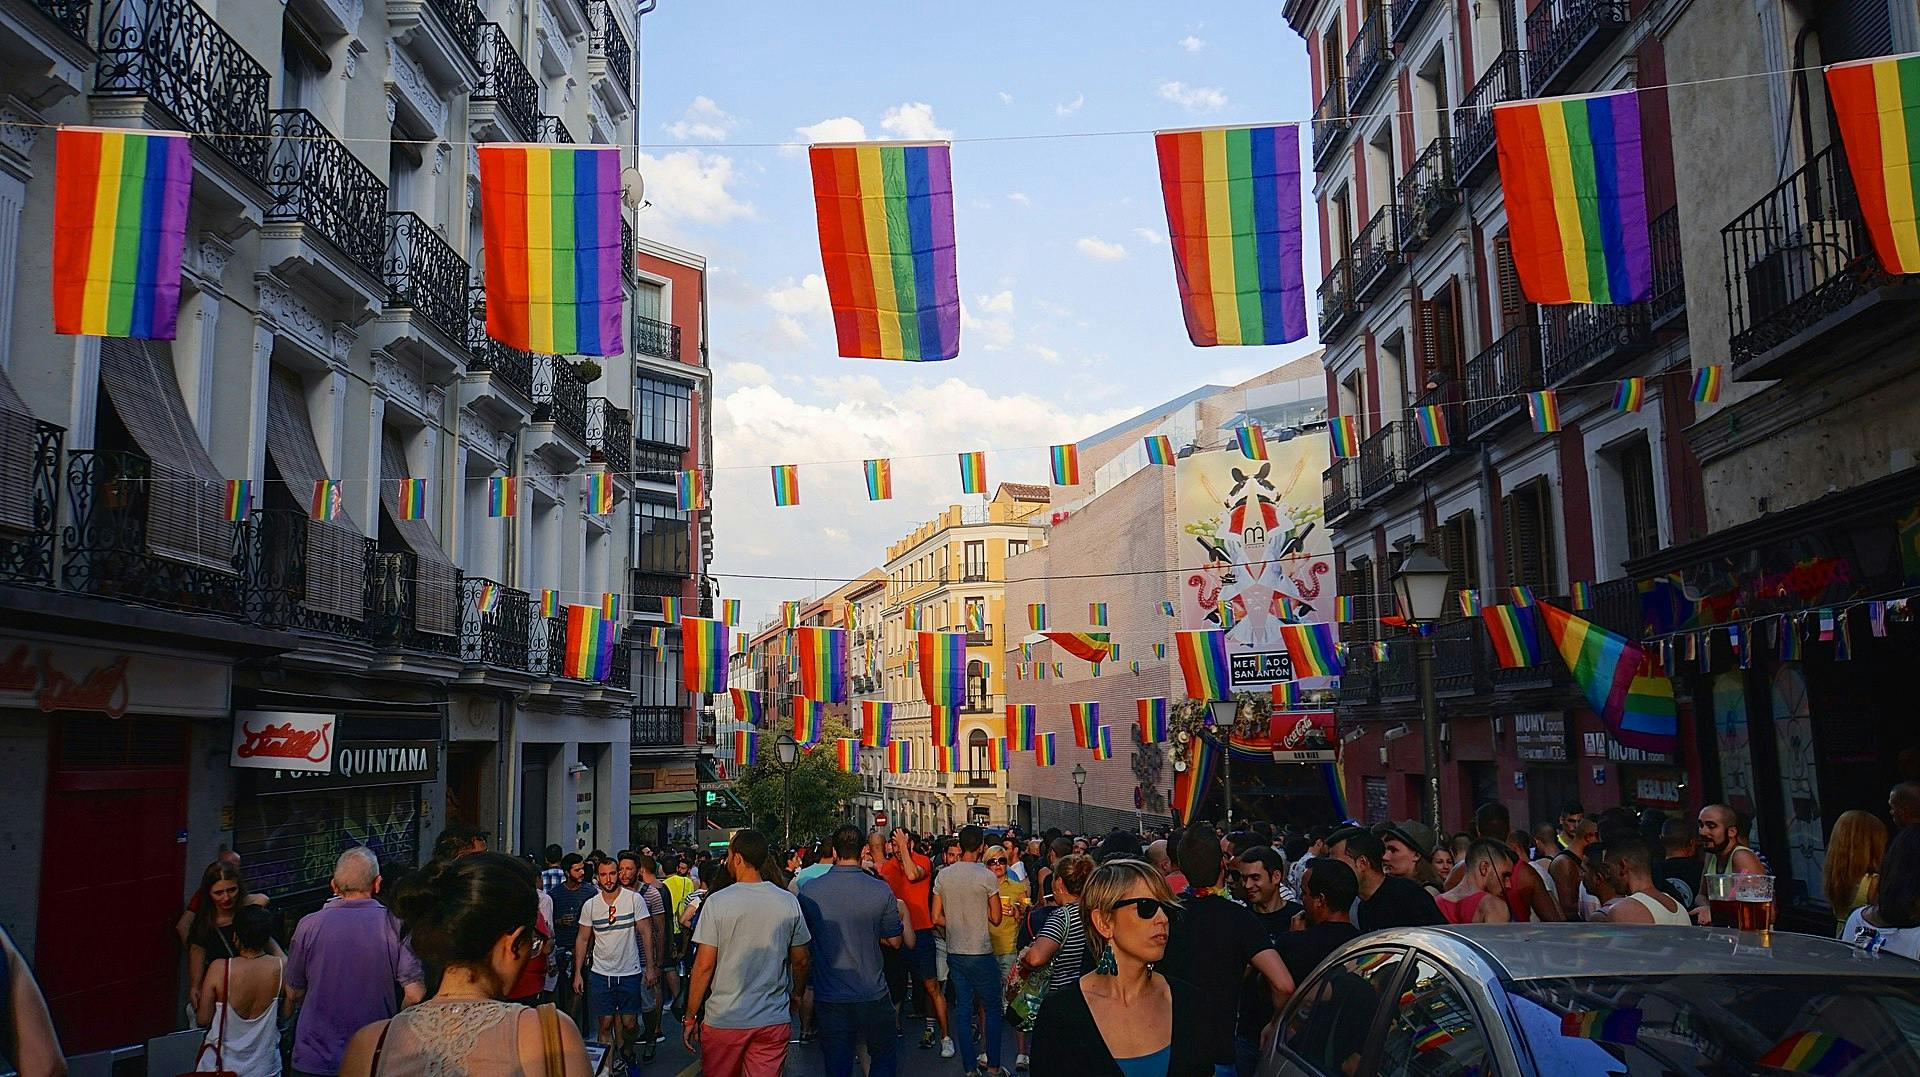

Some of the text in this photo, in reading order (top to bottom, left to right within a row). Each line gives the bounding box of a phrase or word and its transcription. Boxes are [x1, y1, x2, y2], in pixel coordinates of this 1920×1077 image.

[1233, 657, 1289, 669] MERADO
[1234, 667, 1290, 679] SAN ANTÓN
[1515, 714, 1545, 732] MUMY
[339, 747, 428, 778] QUINTANA
[1637, 779, 1680, 802] REBAJAS
